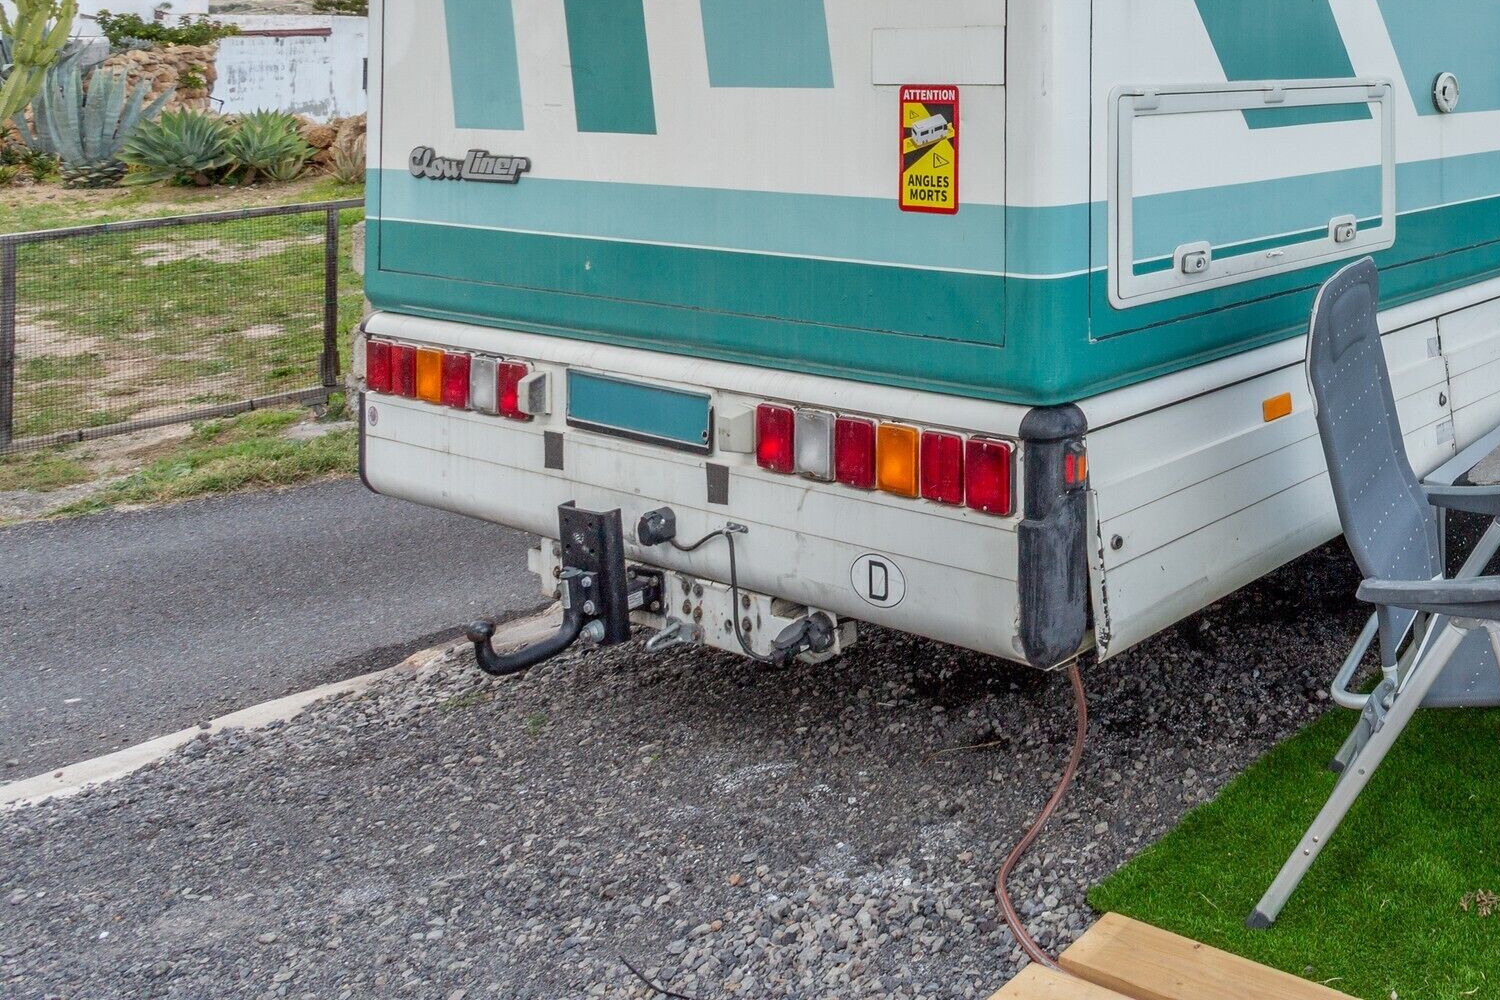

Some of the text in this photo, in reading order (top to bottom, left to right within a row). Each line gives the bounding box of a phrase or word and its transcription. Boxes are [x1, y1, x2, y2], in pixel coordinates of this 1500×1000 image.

[903, 89, 956, 101] ATTENTION
[907, 174, 950, 188] ANGLES
[909, 188, 948, 202] MORTS
[868, 559, 889, 602] D
